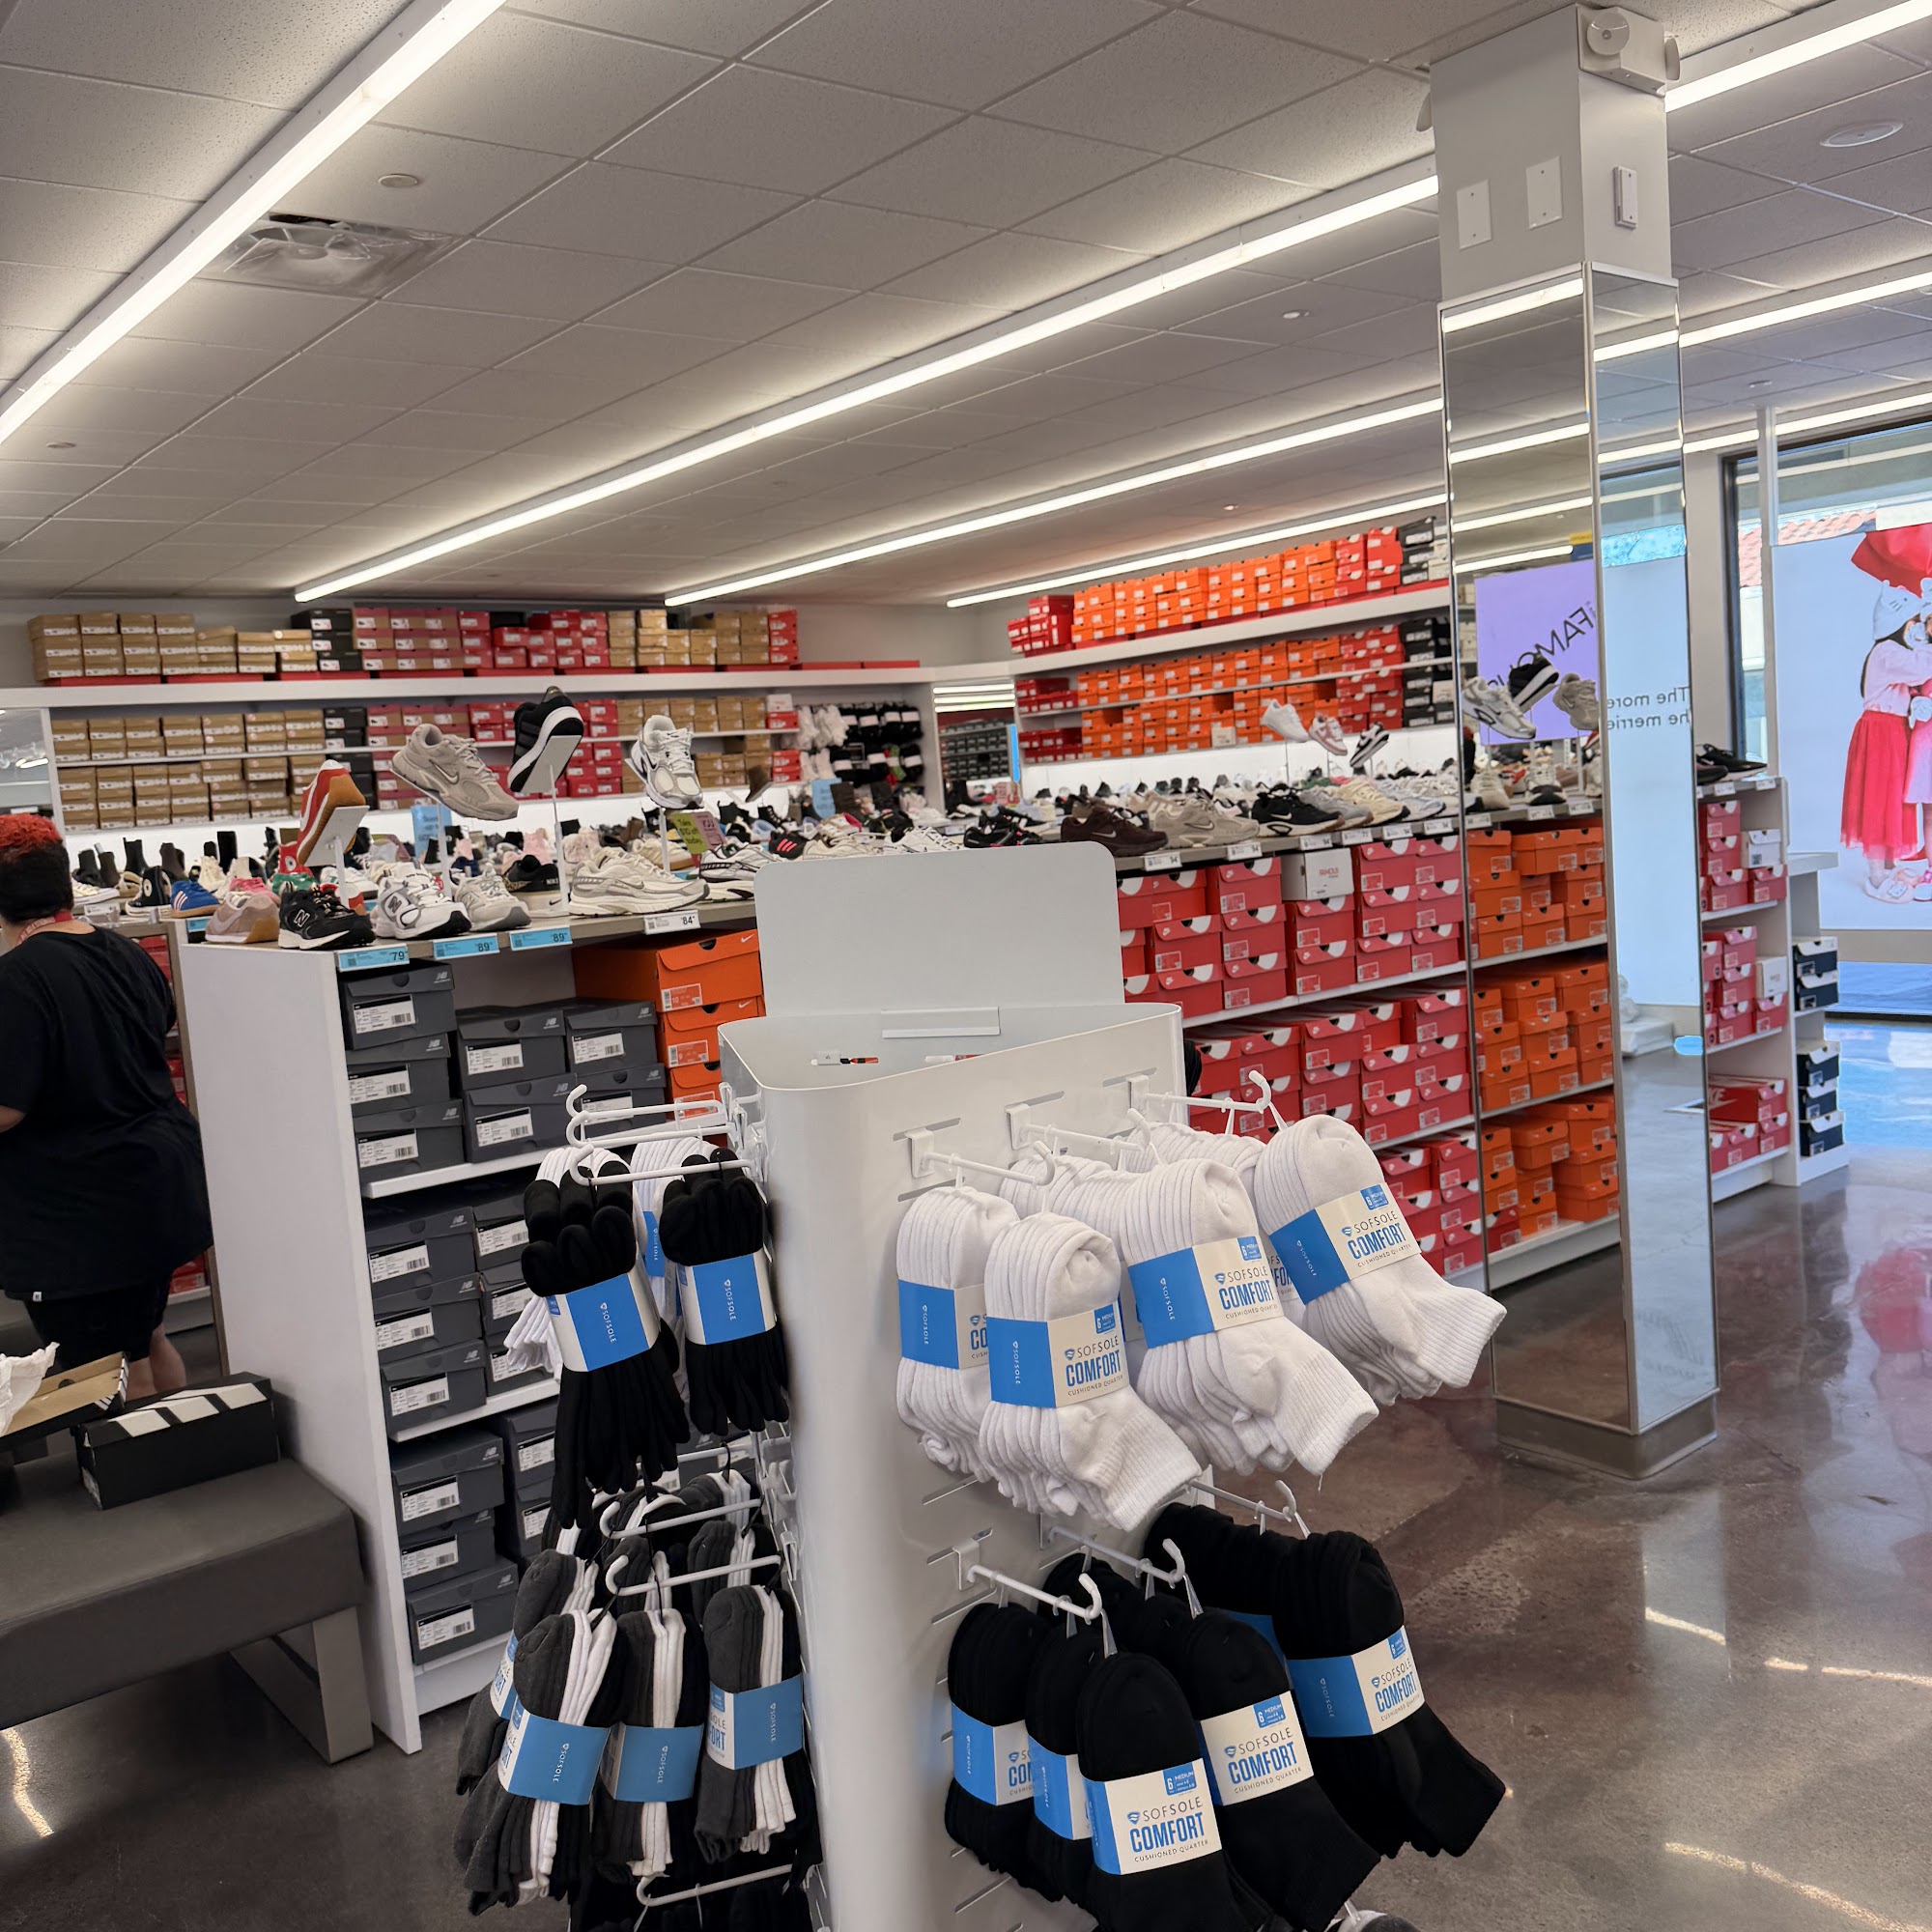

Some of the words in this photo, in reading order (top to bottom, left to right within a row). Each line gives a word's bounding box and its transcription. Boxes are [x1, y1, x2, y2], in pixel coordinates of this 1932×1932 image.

[1366, 1196, 1372, 1207] 6
[1354, 1210, 1398, 1234] SOFSOLE
[1348, 1223, 1406, 1260] COMFORT
[1358, 1251, 1391, 1267] CUSHIONED
[1228, 1266, 1267, 1283] SOFSOLE
[725, 1287, 737, 1321] SOFSOLE
[1162, 1286, 1175, 1321] SOFSOLE
[1219, 1280, 1274, 1310] COMFORT
[602, 1309, 617, 1345] SOFSOLE
[1226, 1307, 1259, 1320] CUSHIONED
[1078, 1335, 1119, 1358] SOFSOLE
[1066, 1350, 1121, 1387] COMFORT
[1068, 1383, 1101, 1397] CUSHIONED
[1381, 1658, 1412, 1685] SOFSOLE
[1376, 1671, 1417, 1714] COMFORT
[1258, 1712, 1264, 1723] 6
[1238, 1727, 1294, 1754] SOFSOLE
[553, 1748, 569, 1782] SOFSOLE
[657, 1751, 668, 1784] SOFSOLE
[1228, 1741, 1297, 1785] COMFORT
[1010, 1785, 1034, 1796] CUSHIO
[1167, 1777, 1173, 1790] 6
[1235, 1777, 1274, 1794] CUSHIONED
[1275, 1766, 1302, 1781] QUARTER
[1143, 1797, 1204, 1822] SOFSOLE
[1130, 1812, 1205, 1853] COMFORT
[1134, 1847, 1178, 1862] CUSHIONED
[1179, 1839, 1208, 1853] QUARTER
